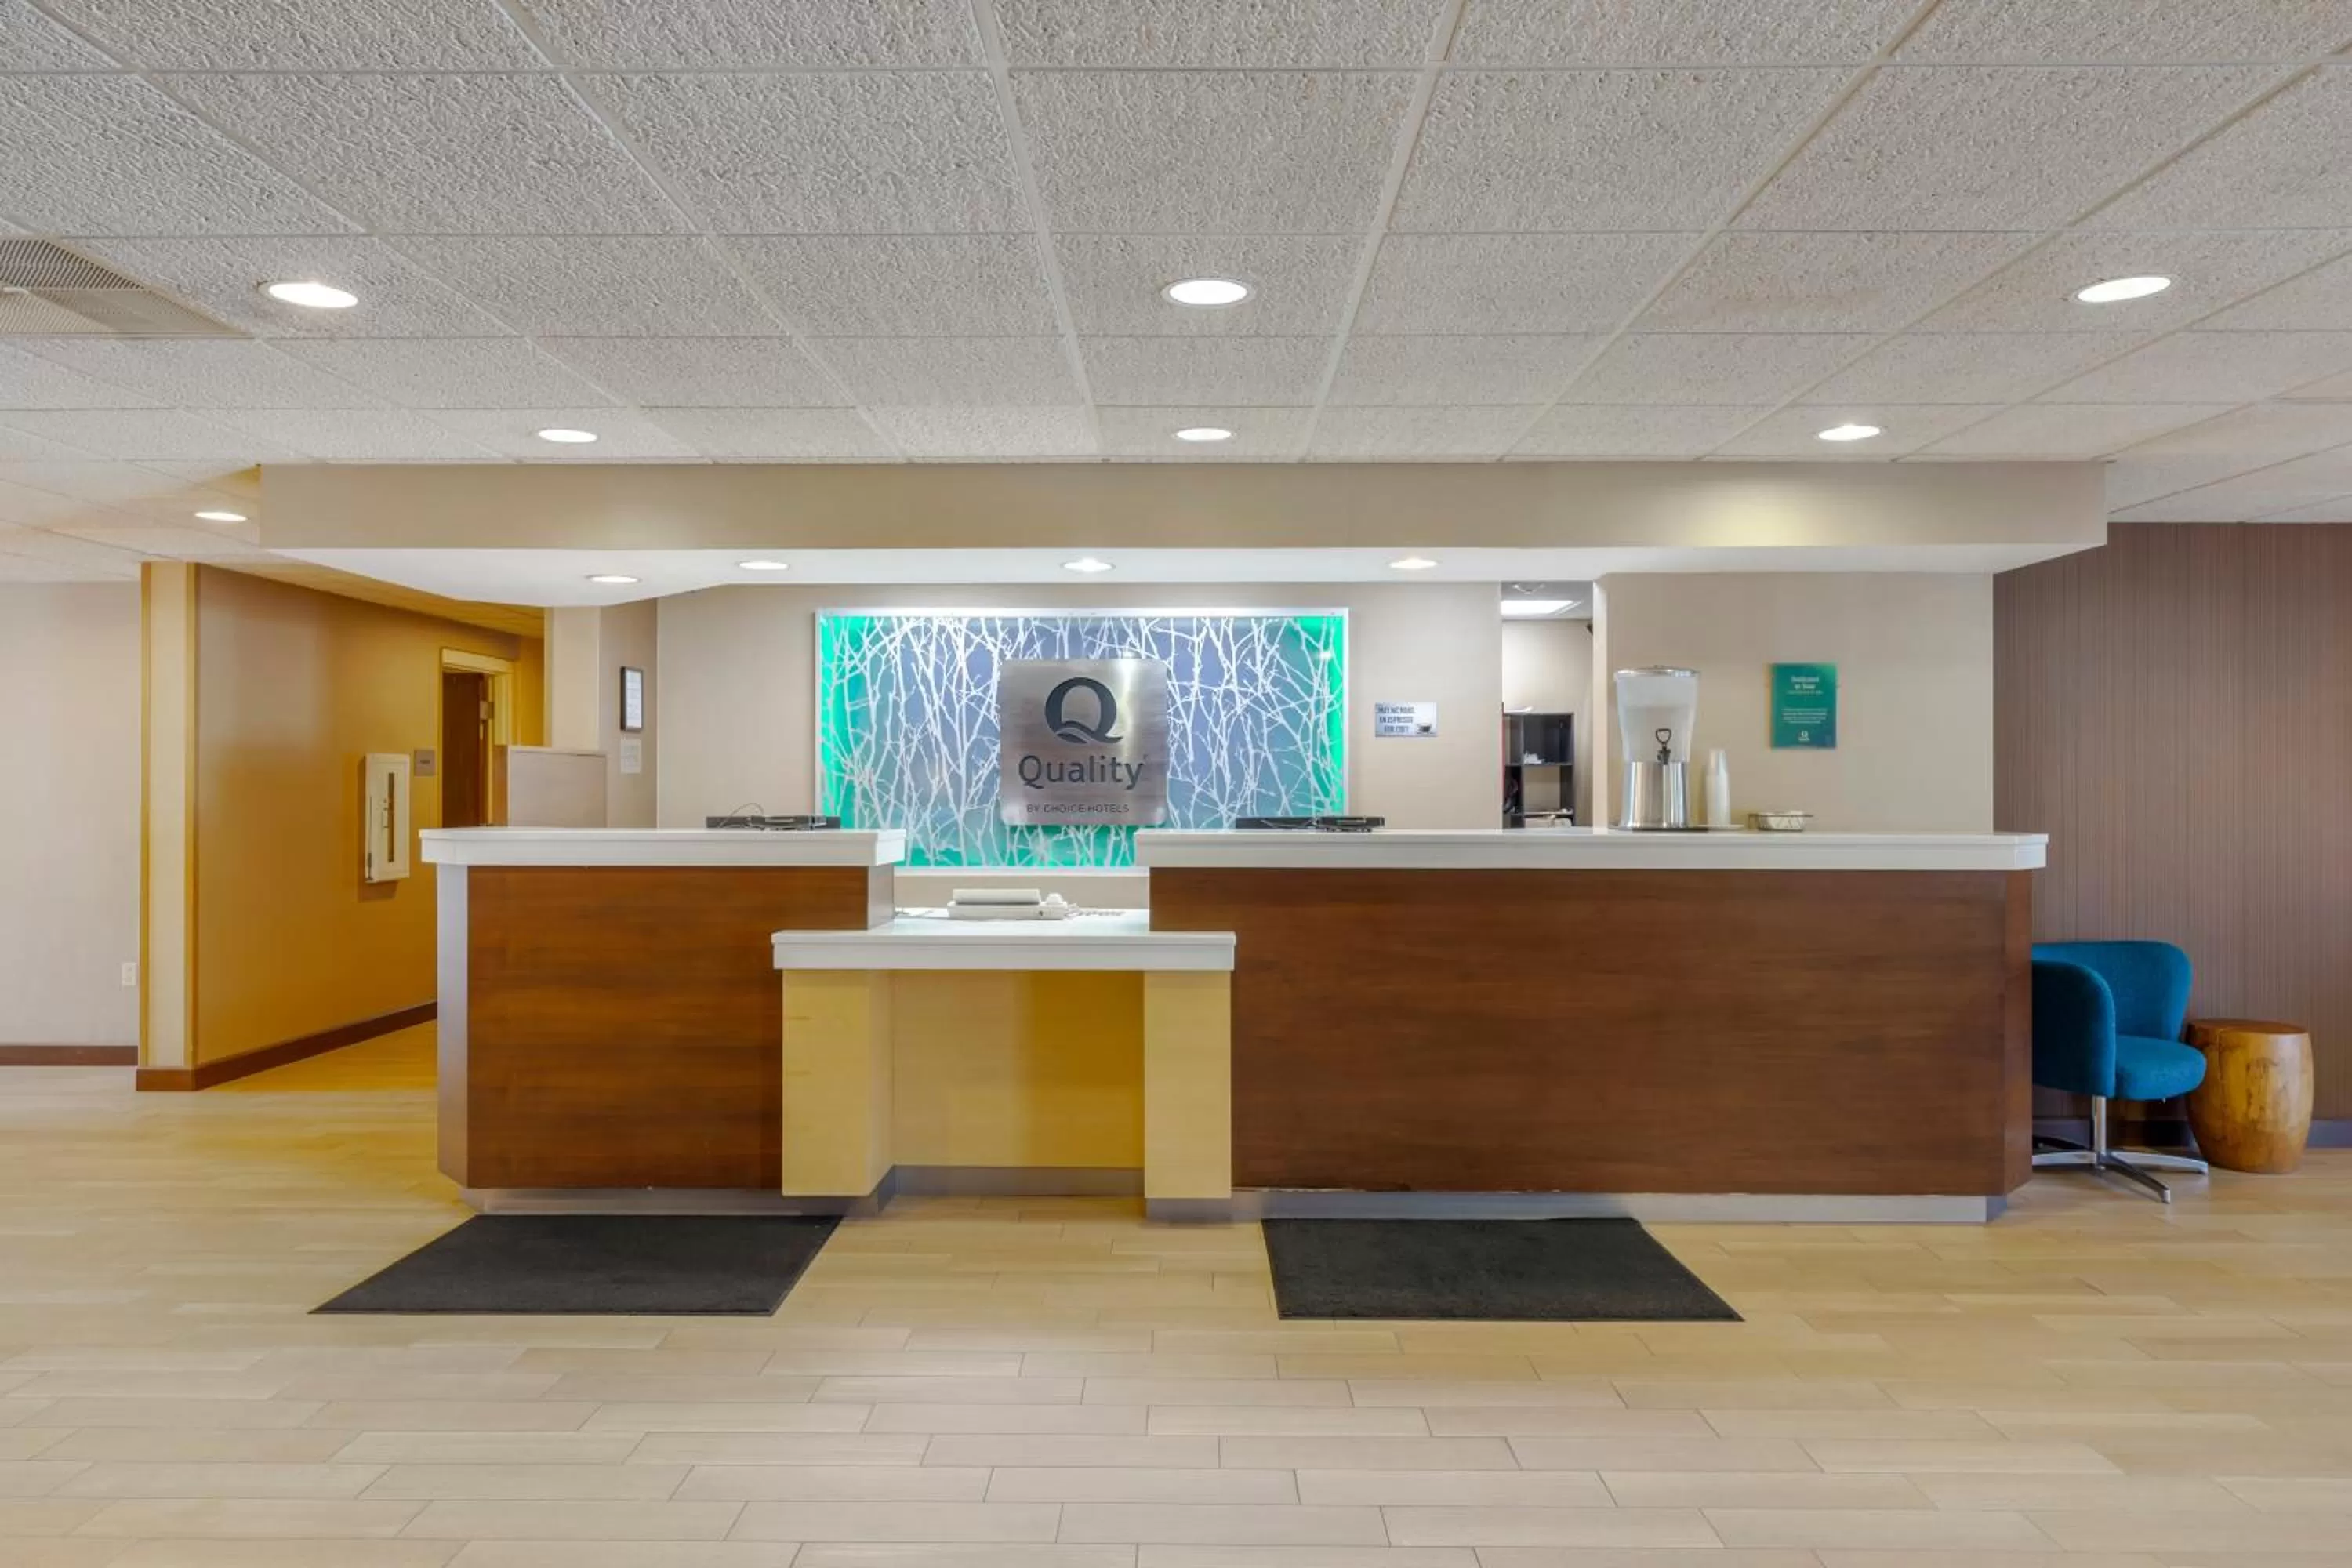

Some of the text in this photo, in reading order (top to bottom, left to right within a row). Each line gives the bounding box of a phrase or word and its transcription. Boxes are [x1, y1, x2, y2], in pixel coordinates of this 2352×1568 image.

[1045, 677, 1123, 744] Q
[1018, 754, 1145, 791] Quality
[1026, 804, 1130, 813] BY CHOICE HOTELS
